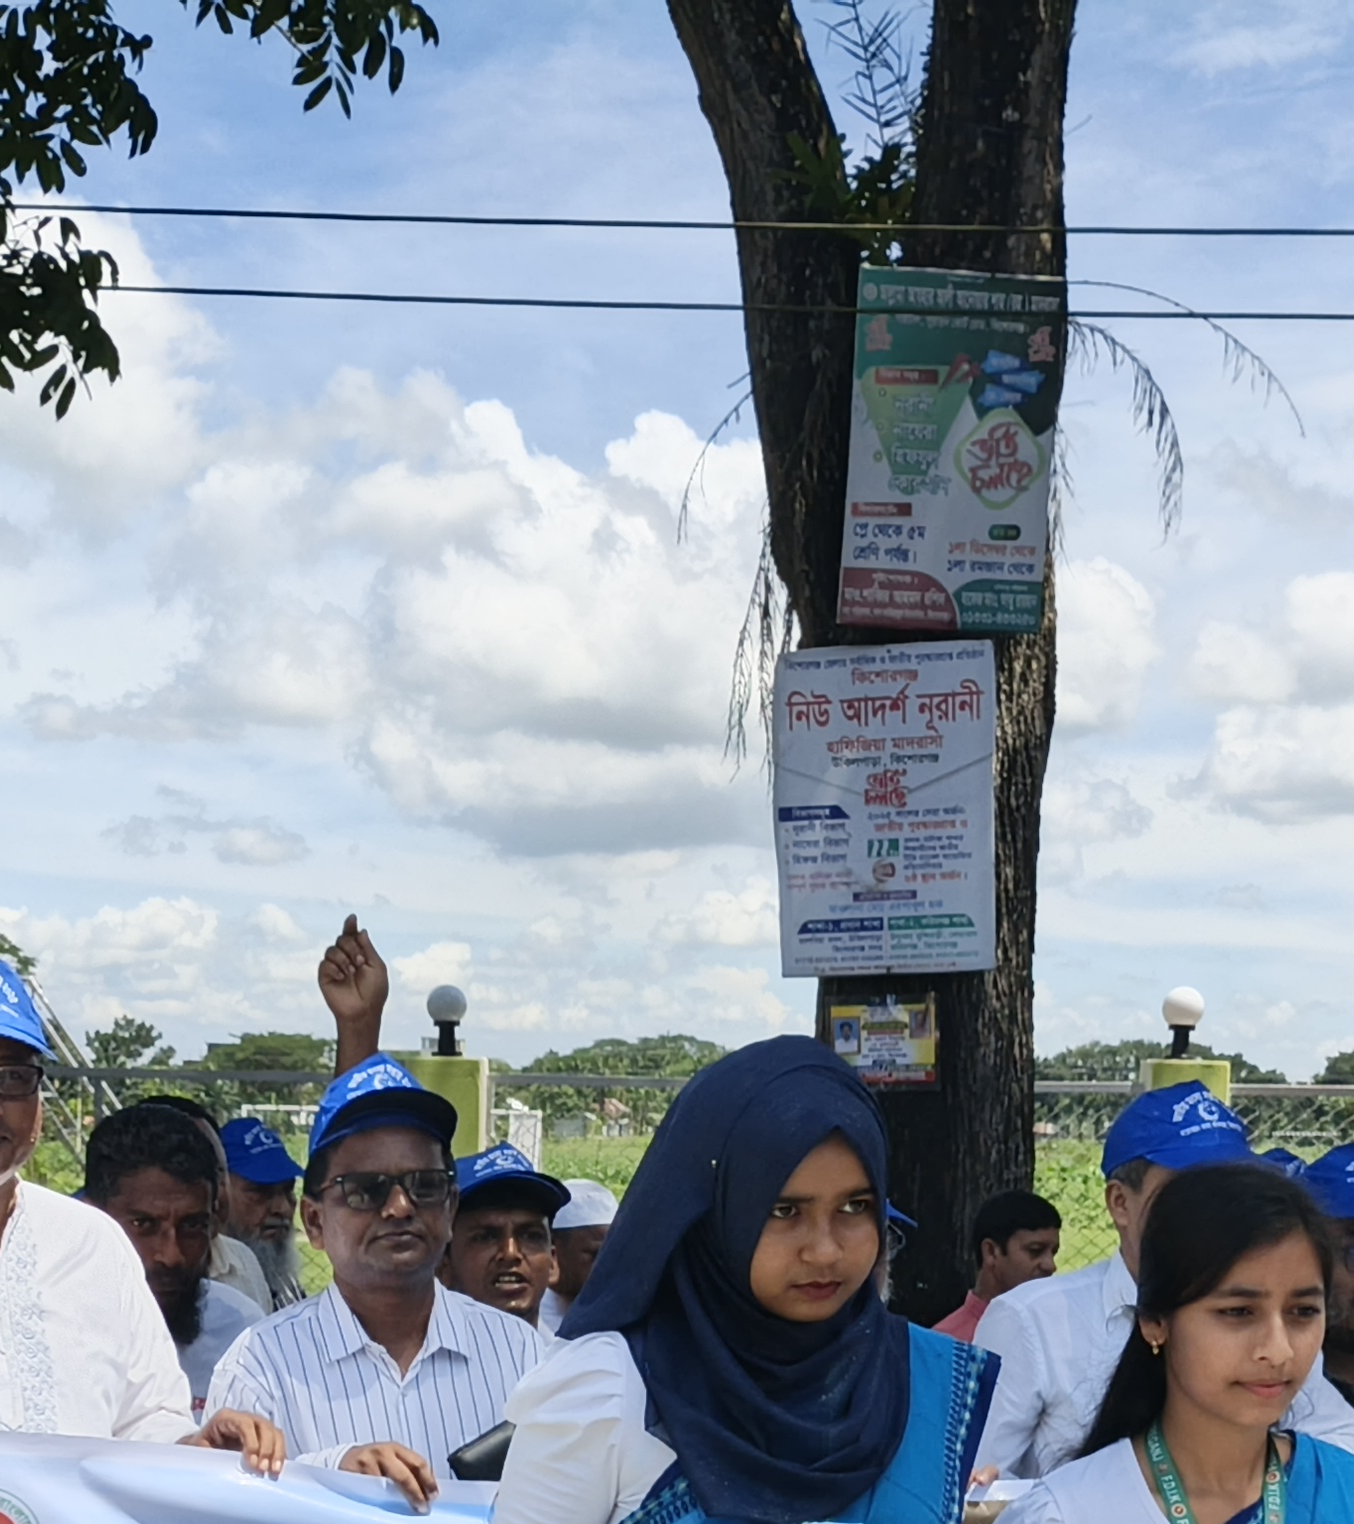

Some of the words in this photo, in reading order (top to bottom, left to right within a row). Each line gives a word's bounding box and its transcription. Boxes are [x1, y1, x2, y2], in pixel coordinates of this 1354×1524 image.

[851, 667, 919, 686] কিশোরগঞ্জ
[785, 690, 833, 732] নিউ
[839, 683, 910, 728] আদর্শ
[916, 678, 985, 733] নূরানী
